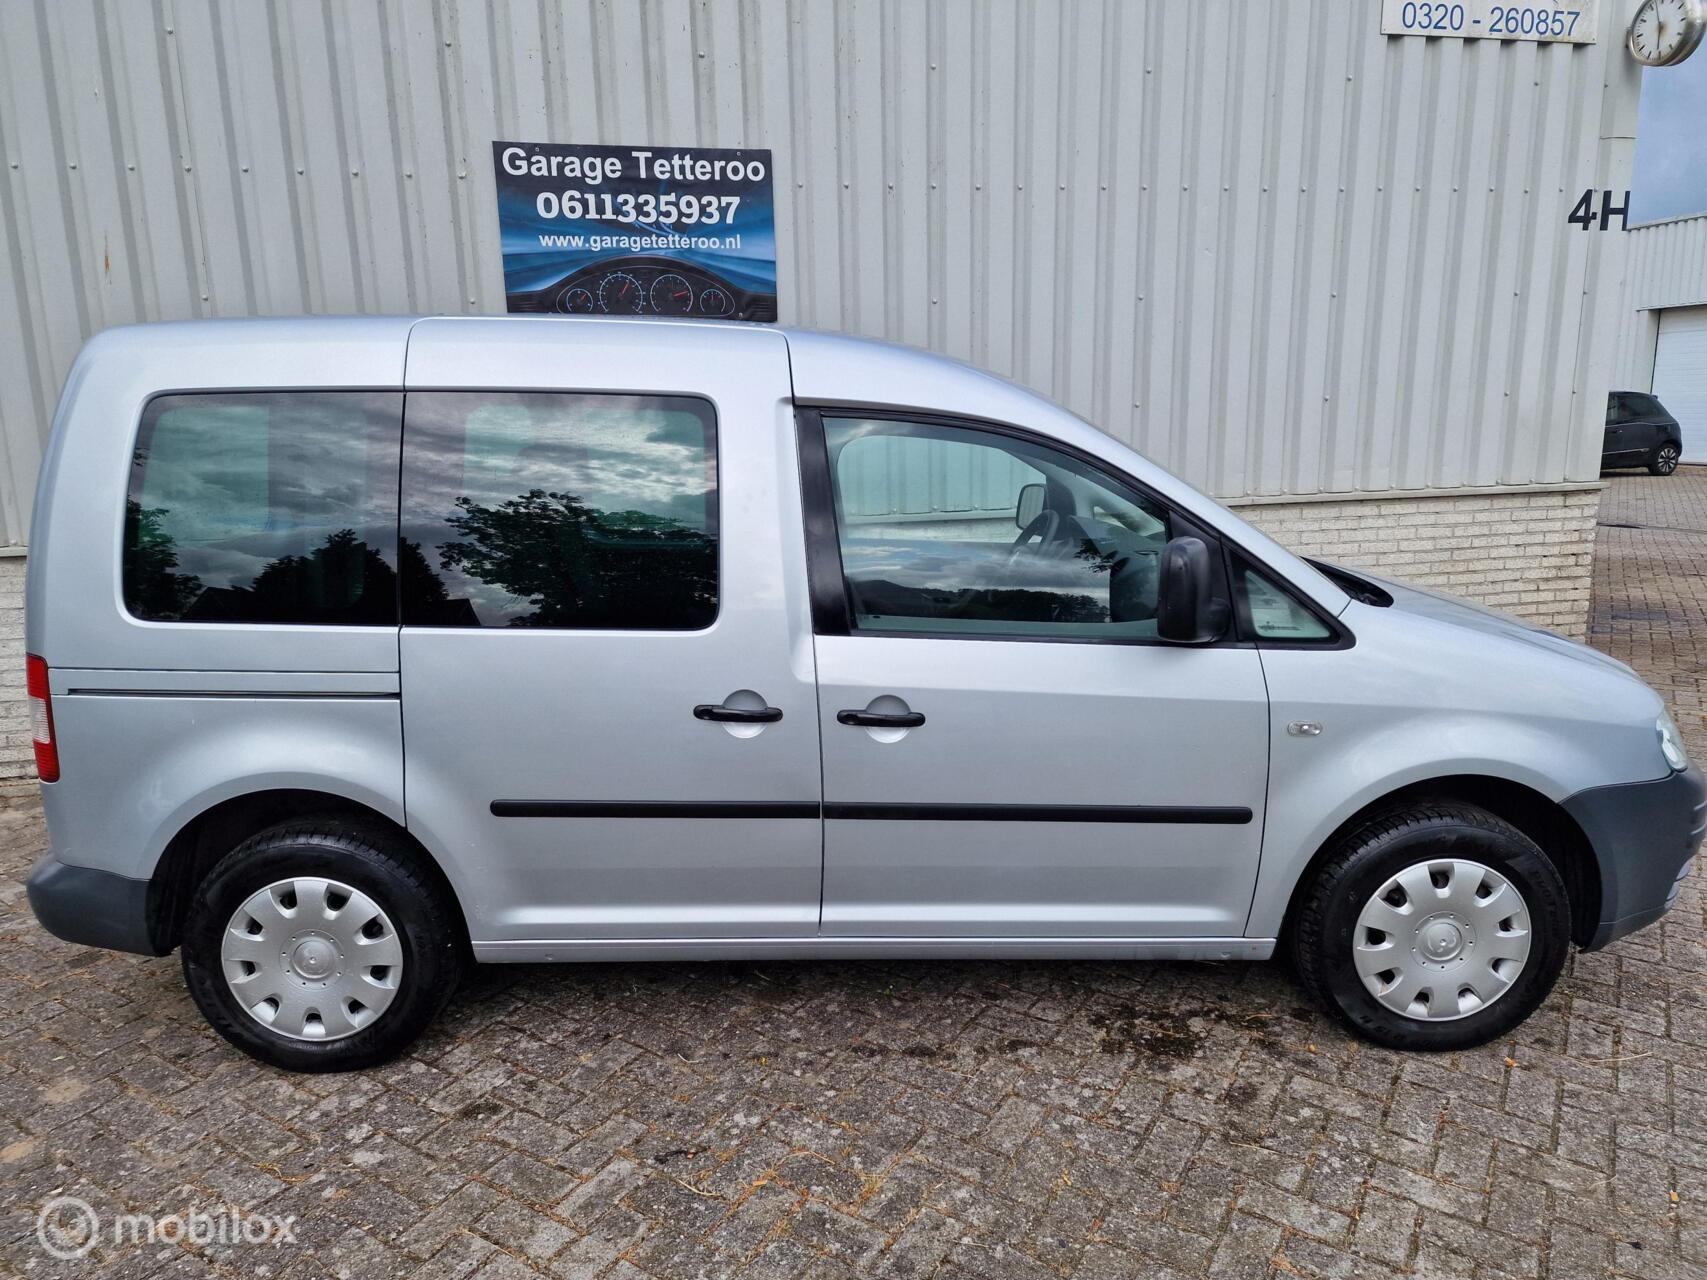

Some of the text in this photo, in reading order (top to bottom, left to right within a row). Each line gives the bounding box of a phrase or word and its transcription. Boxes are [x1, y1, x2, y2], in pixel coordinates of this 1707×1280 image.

[1402, 2, 1464, 30] 0320
[1489, 7, 1581, 36] 260857
[502, 147, 765, 184] Garage Tetteroo
[536, 190, 741, 224] 0611335937
[1567, 188, 1631, 231] 4H
[539, 234, 741, 251] www.garagetetteroo.nl
